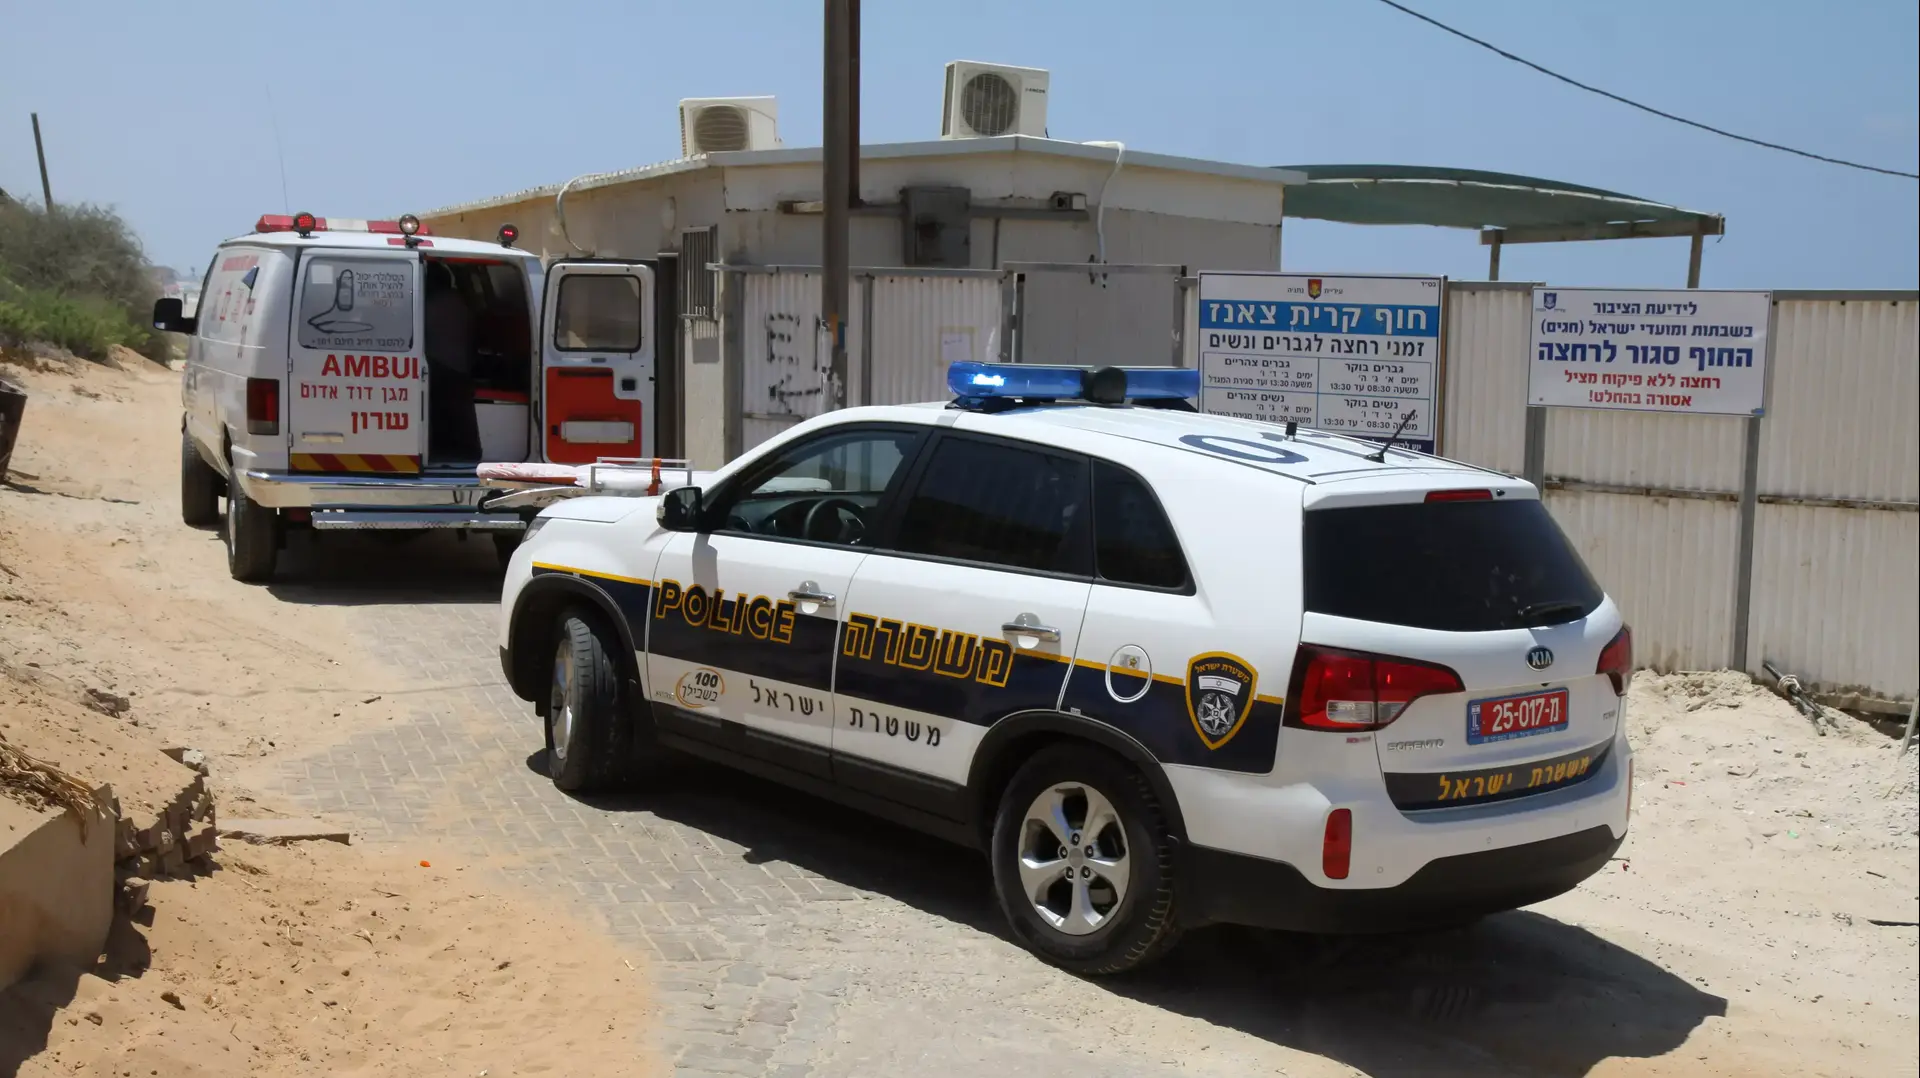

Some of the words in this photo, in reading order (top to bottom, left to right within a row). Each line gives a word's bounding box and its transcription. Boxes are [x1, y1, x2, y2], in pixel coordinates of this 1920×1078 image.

[1210, 304, 1276, 324] צאנז
[1593, 303, 1640, 314] הציבור
[1645, 302, 1697, 315] לידיעת
[1290, 306, 1361, 332] קרית
[1376, 308, 1426, 334] חוף
[1541, 319, 1584, 336] (חגים)
[1589, 320, 1635, 334] ישראל
[1640, 324, 1686, 336] ומועדי
[1691, 326, 1753, 338] בשבתות
[1210, 334, 1256, 349] ונשים
[1264, 334, 1323, 352] לגברים
[1331, 338, 1378, 355] רחצה
[1387, 341, 1424, 356] זמני
[1539, 340, 1617, 362] לרחצה
[1626, 345, 1680, 365] סגור
[1262, 360, 1290, 368] גברים
[1689, 346, 1753, 371] החוף
[1345, 363, 1368, 372] בוקר
[1374, 364, 1404, 373] גברים
[1296, 372, 1312, 380] ימים
[1401, 376, 1418, 384] ימים
[1564, 370, 1598, 384] מציל
[1602, 372, 1642, 388] פיקוח
[1648, 373, 1675, 387] ללא
[1680, 376, 1720, 388] רחצה
[301, 383, 338, 400] אדום
[346, 386, 373, 400] דוד
[1354, 384, 1364, 392] עד
[1394, 386, 1418, 394] משעה
[382, 387, 408, 404] מגן
[1227, 392, 1257, 400] צהרים
[1261, 394, 1284, 402] נשים
[1589, 390, 1641, 404] בהחלט!
[1646, 394, 1692, 406] אסורה
[1296, 406, 1312, 414] ימים
[1344, 399, 1368, 408] בוקר
[1372, 400, 1398, 409] נשים
[351, 412, 408, 434] שרון
[1270, 414, 1288, 422] 13:30
[1324, 418, 1344, 426] 13:30
[1366, 421, 1390, 429] 08:30
[656, 578, 797, 644] POLICE
[843, 612, 1014, 688] משטרה
[1532, 651, 1552, 666] KIA
[1194, 663, 1220, 674] ישראל
[1222, 664, 1250, 683] משטרת
[694, 672, 718, 688] 100
[682, 684, 718, 702] בשבילך
[750, 679, 824, 715] ישראל
[850, 708, 940, 746] משטרת
[1387, 738, 1445, 750] SORENTO
[1528, 756, 1590, 788] משטרת
[1438, 772, 1512, 800] ישראל
